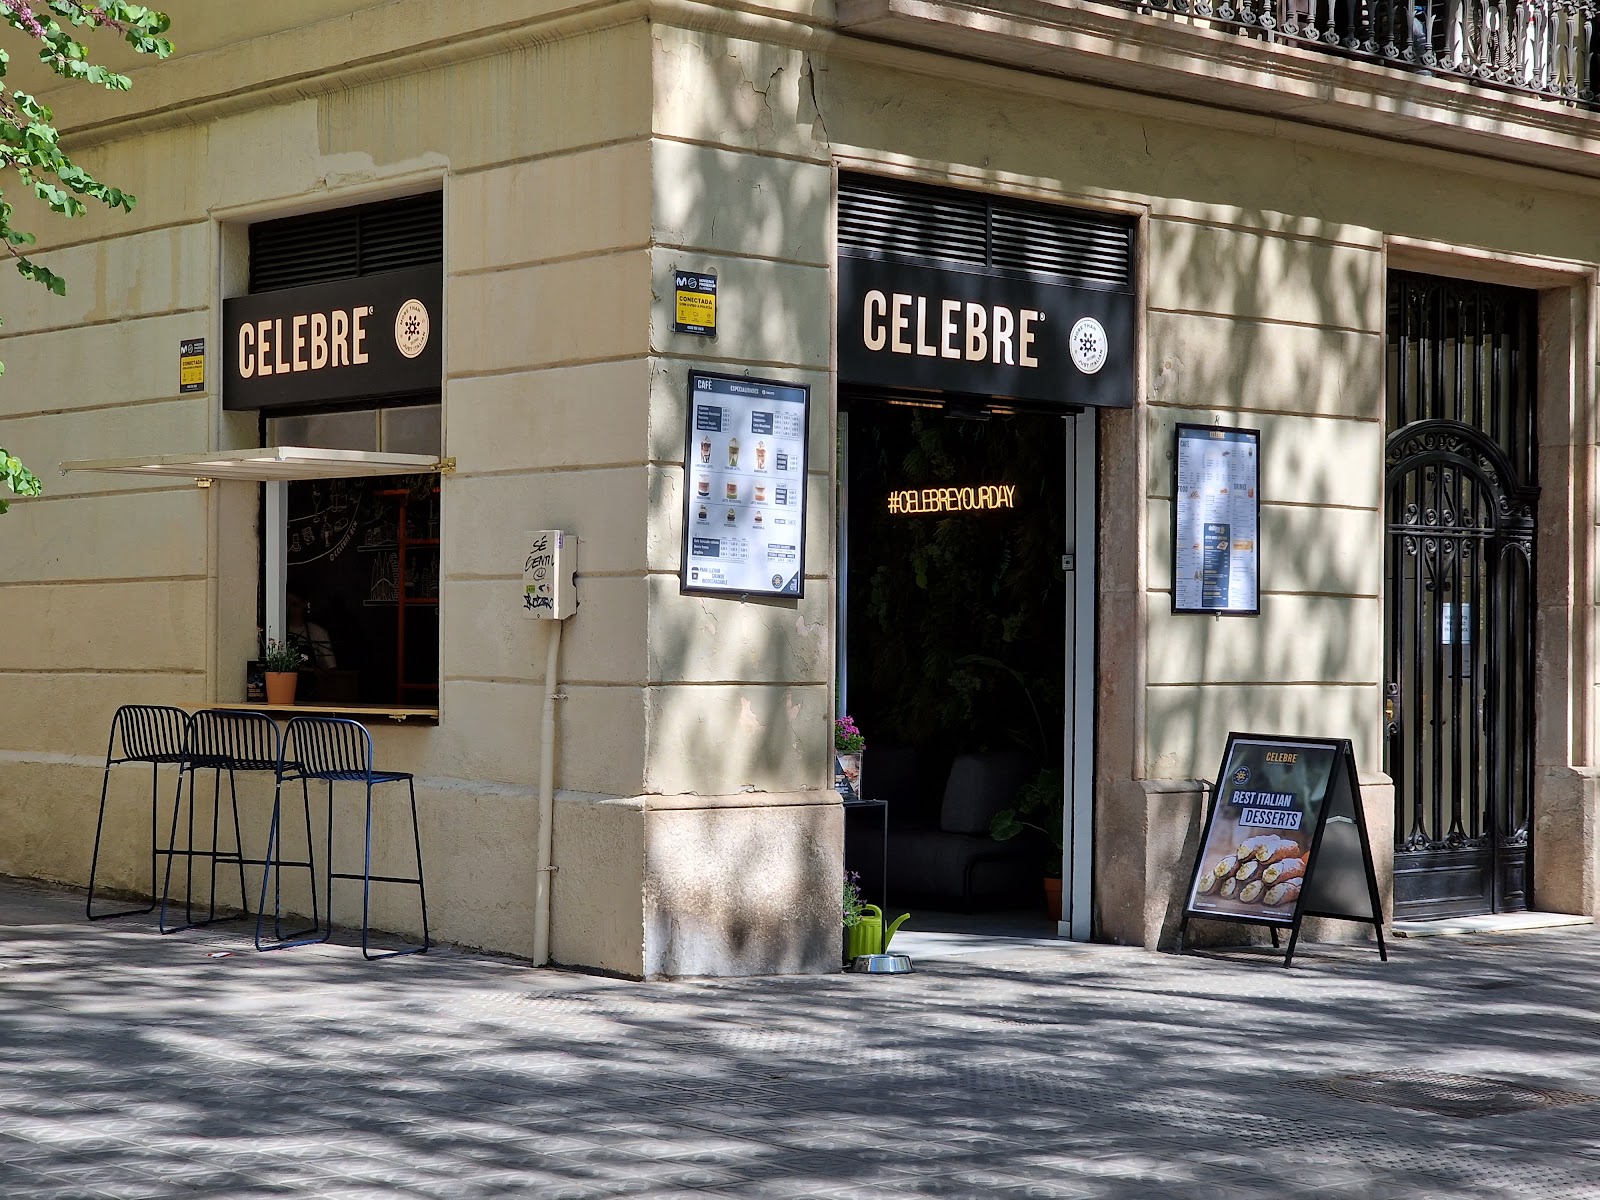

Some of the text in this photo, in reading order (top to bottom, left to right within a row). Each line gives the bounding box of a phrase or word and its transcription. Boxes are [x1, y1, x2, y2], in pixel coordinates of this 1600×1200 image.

[679, 296, 713, 305] CONECTADA
[399, 308, 409, 325] MORE
[863, 289, 1039, 368] CELEBRE
[1073, 323, 1097, 341] MORE THAN
[239, 305, 370, 379] CELEBRE
[413, 331, 426, 352] ITALIAN
[1078, 360, 1089, 368] JUST
[1090, 349, 1103, 367] ITALIAN
[887, 485, 1016, 514] #CELEBREYOURDAY
[1265, 751, 1298, 764] CELEBRE
[1232, 790, 1292, 808] BEST ITALIAN
[1245, 809, 1299, 827] DESSERTS
